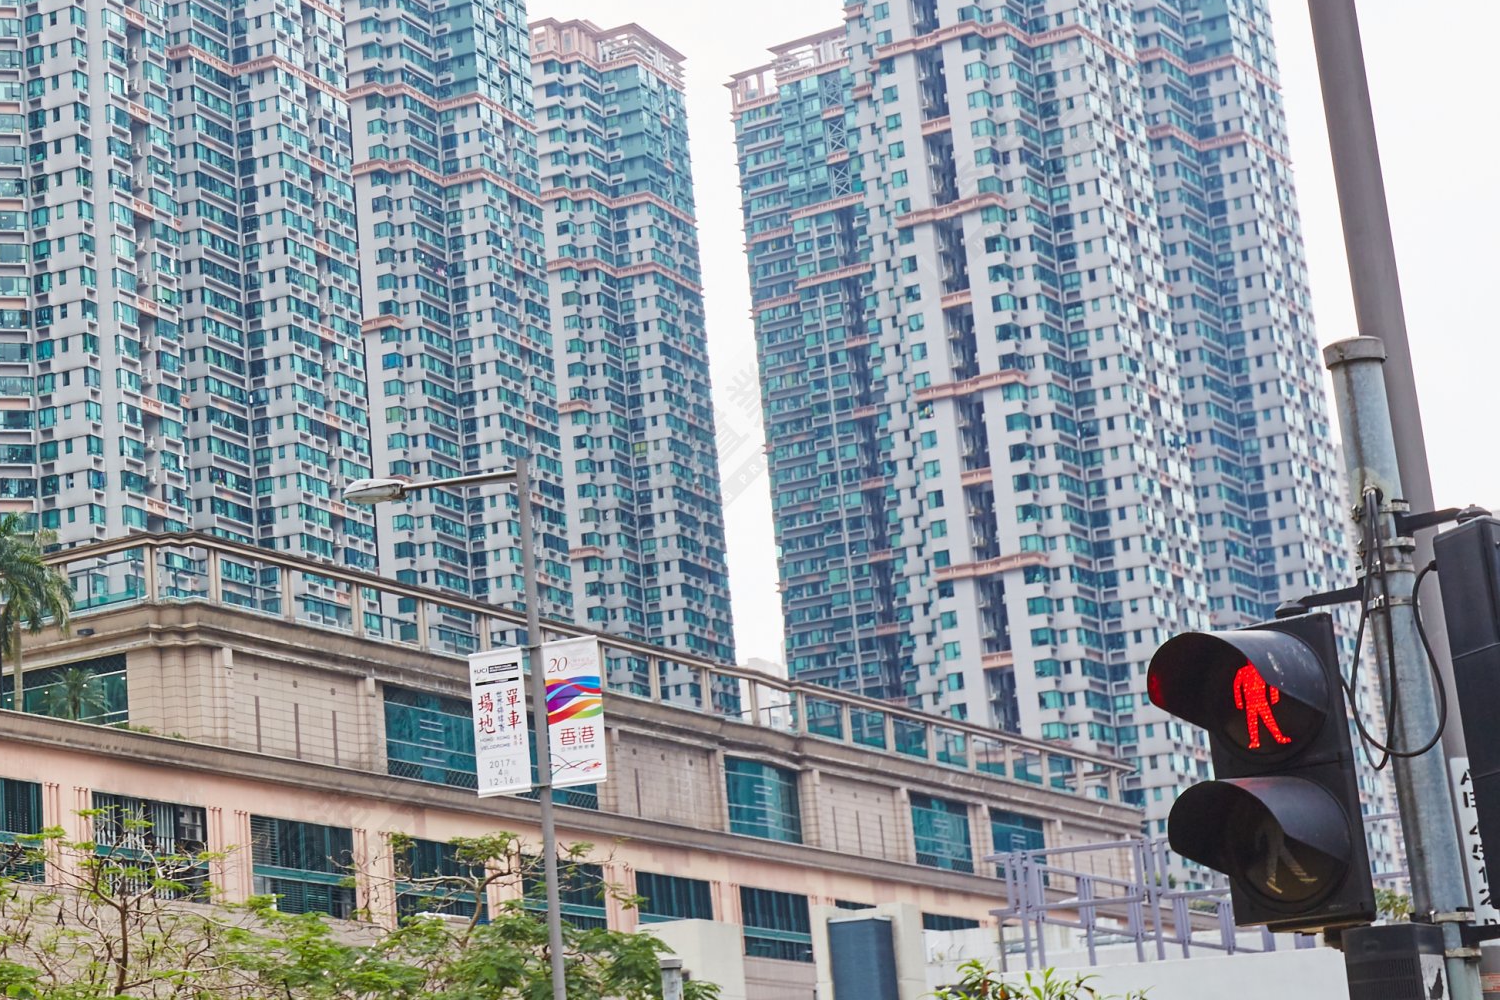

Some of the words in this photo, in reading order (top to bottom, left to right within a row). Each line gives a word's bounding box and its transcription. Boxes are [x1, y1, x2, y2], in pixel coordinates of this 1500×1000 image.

[547, 656, 568, 673] 20
[478, 692, 496, 734] 場地
[506, 688, 522, 731] 單車
[560, 726, 595, 746] 香港
